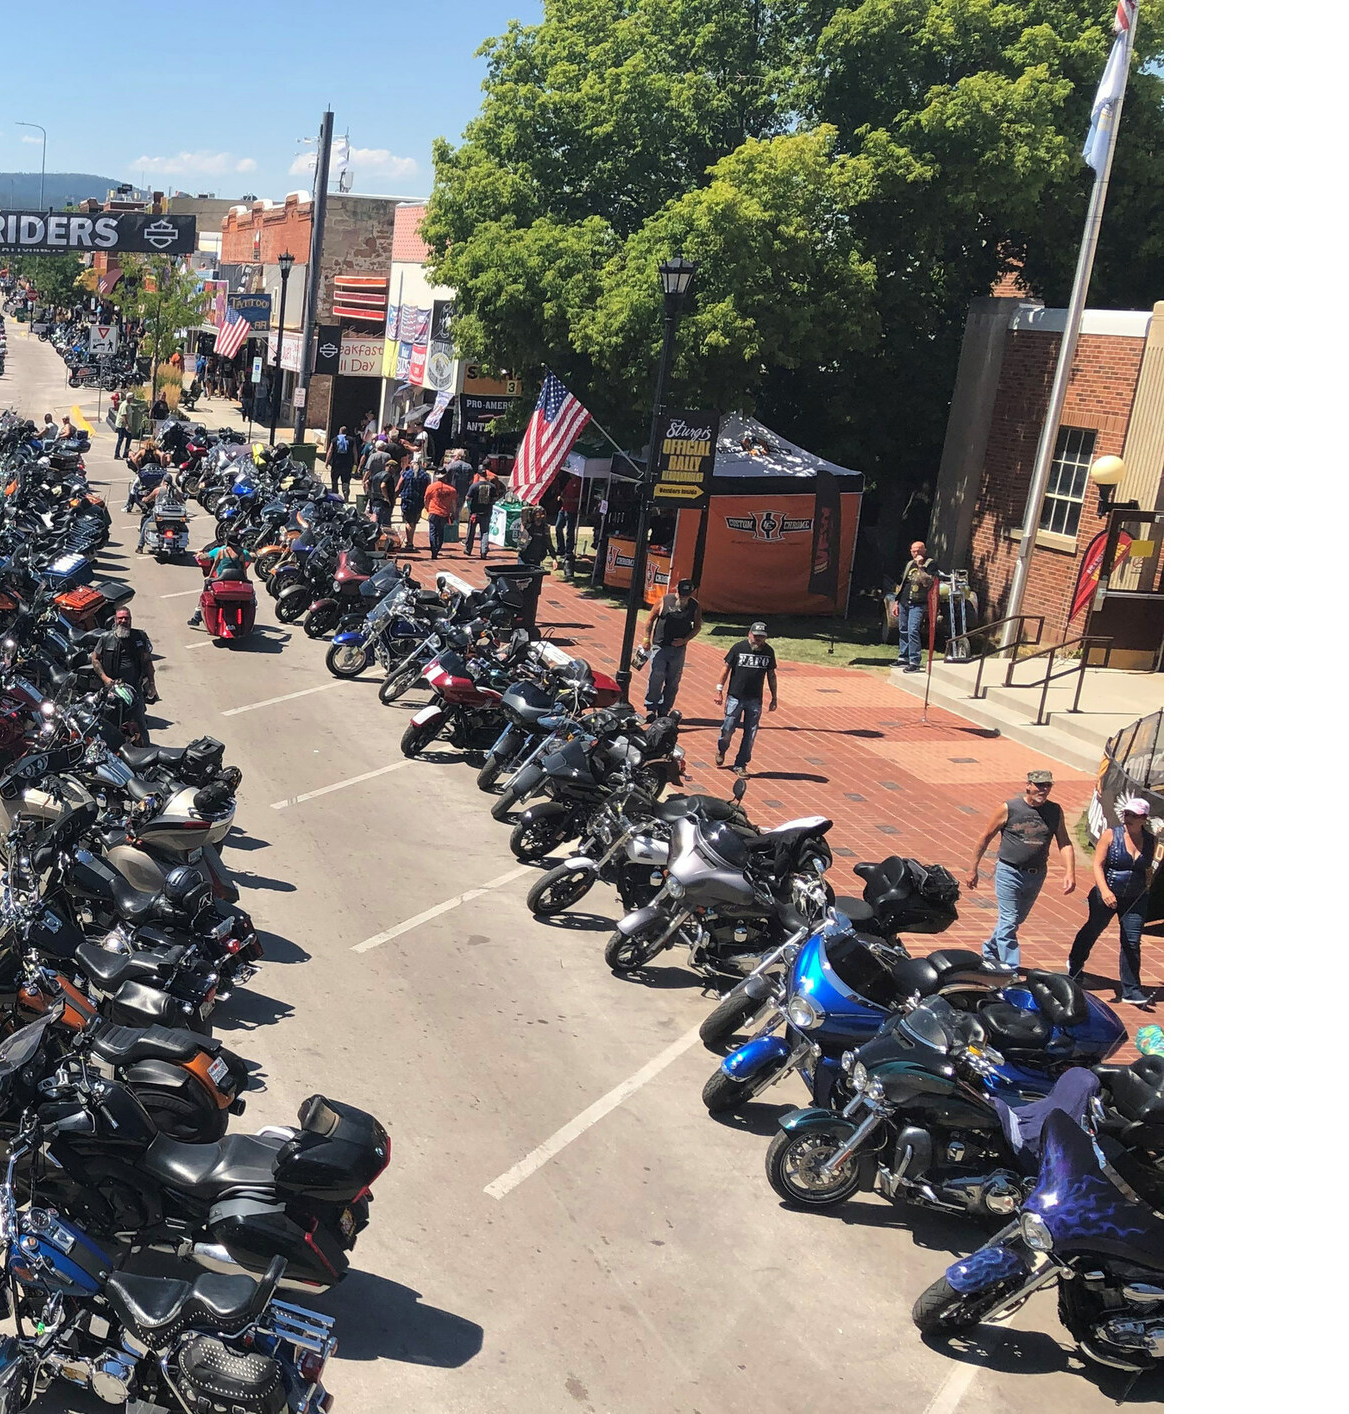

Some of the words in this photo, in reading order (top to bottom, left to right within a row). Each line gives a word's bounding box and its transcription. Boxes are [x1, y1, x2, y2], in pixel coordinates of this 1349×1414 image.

[339, 344, 384, 356] eakfast
[351, 360, 376, 372] Day
[508, 382, 515, 392] 3
[666, 420, 712, 442] Sturgis
[662, 438, 711, 456] OFFICIAL
[668, 456, 703, 472] RALLY
[728, 519, 754, 529] CUSTOM
[784, 520, 810, 529] CHROME
